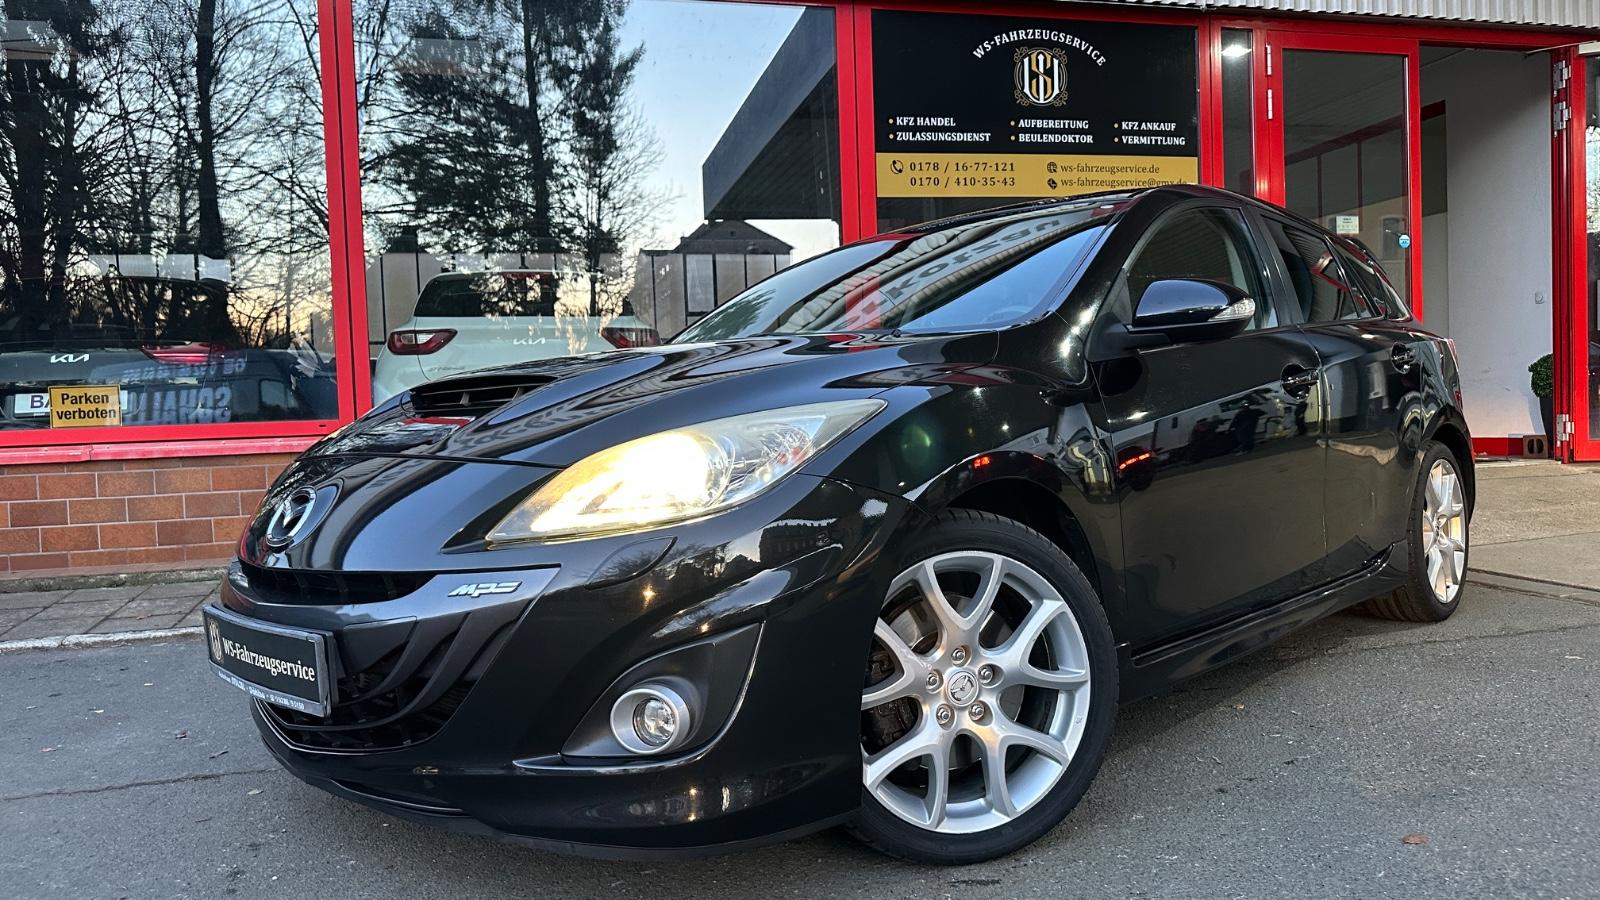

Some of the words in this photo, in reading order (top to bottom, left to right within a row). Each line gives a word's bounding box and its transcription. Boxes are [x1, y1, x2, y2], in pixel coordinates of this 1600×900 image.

[973, 29, 1107, 67] WS-FAHRZEUGSERVICE
[896, 116, 915, 126] KFZ
[916, 117, 956, 126] HANDEL
[1018, 119, 1089, 129] AUFBEREITUNG
[1121, 121, 1139, 130] KFZ
[1140, 122, 1177, 131] ANKAUF
[896, 131, 991, 142] ZULASSUNGSDIENST
[1018, 133, 1094, 144] BEULENDOKTOR
[1121, 135, 1186, 146] VERMITTLUNG
[909, 162, 940, 172] 0178
[954, 162, 1015, 172] 16-77-121
[1060, 163, 1160, 175] ws-fahrzeugservice.de
[910, 177, 940, 187] 0170
[954, 177, 1016, 187] 410-35-43
[1060, 176, 1188, 188] ws-fahrzeugservice@gmxd
[61, 392, 110, 405] Parken
[56, 407, 117, 420] verboten
[447, 581, 523, 598] MPS
[222, 637, 316, 681] WS-Fahrzeugservice
